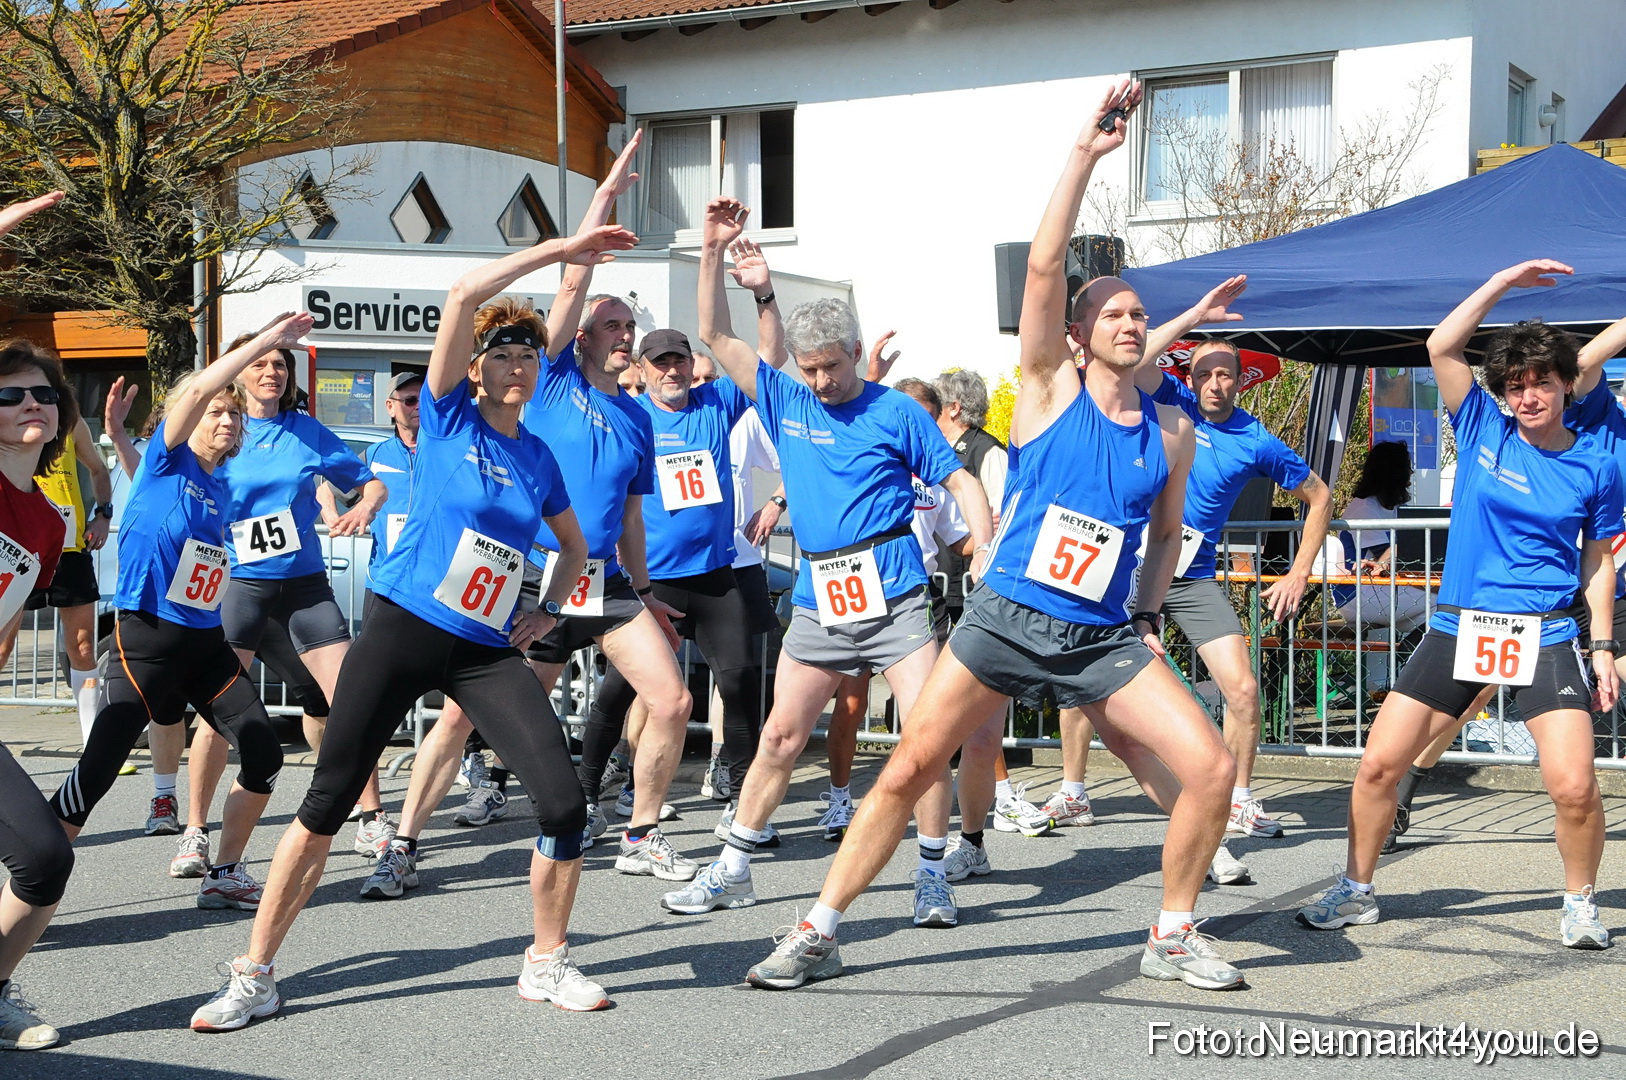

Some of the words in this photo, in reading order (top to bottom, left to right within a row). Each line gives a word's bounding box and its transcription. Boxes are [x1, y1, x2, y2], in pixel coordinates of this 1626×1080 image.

[307, 289, 441, 332] Service
[666, 455, 692, 465] MEYER
[674, 468, 705, 501] 16
[1057, 521, 1094, 540] WERBUNG
[1059, 512, 1097, 532] MEYER
[249, 516, 287, 554] 45
[194, 551, 221, 564] WERBUNG
[195, 545, 223, 559] MEYER
[472, 547, 507, 567] WERBUNG
[474, 537, 511, 560] MEYER
[818, 559, 847, 572] MEYER
[1049, 535, 1101, 587] 57
[185, 562, 224, 604] 58
[460, 566, 508, 618] 61
[563, 575, 591, 608] 3
[826, 575, 868, 617] 69
[1471, 623, 1509, 632] WERBUNG
[1472, 615, 1508, 626] MEYER
[1474, 635, 1521, 679] 56
